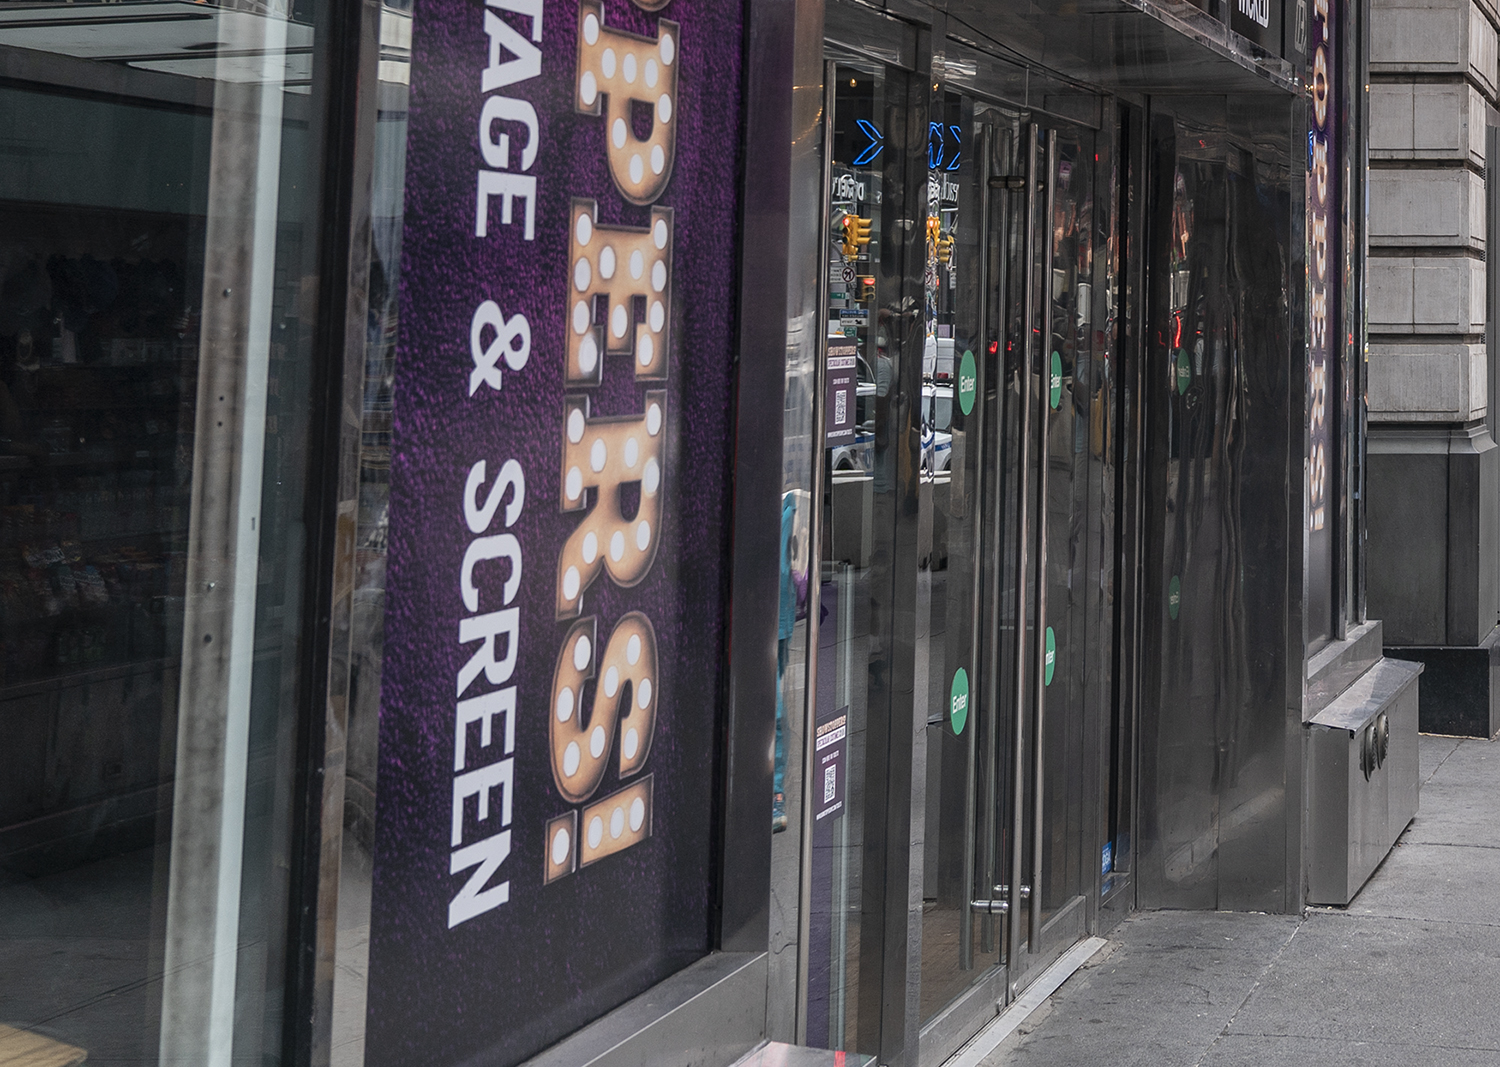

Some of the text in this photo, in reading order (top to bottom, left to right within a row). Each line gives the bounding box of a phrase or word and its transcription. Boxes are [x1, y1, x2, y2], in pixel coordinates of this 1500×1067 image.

[468, 299, 531, 398] &
[961, 376, 975, 393] Enter
[447, 457, 526, 930] SCREEN
[952, 691, 968, 715] Enter
